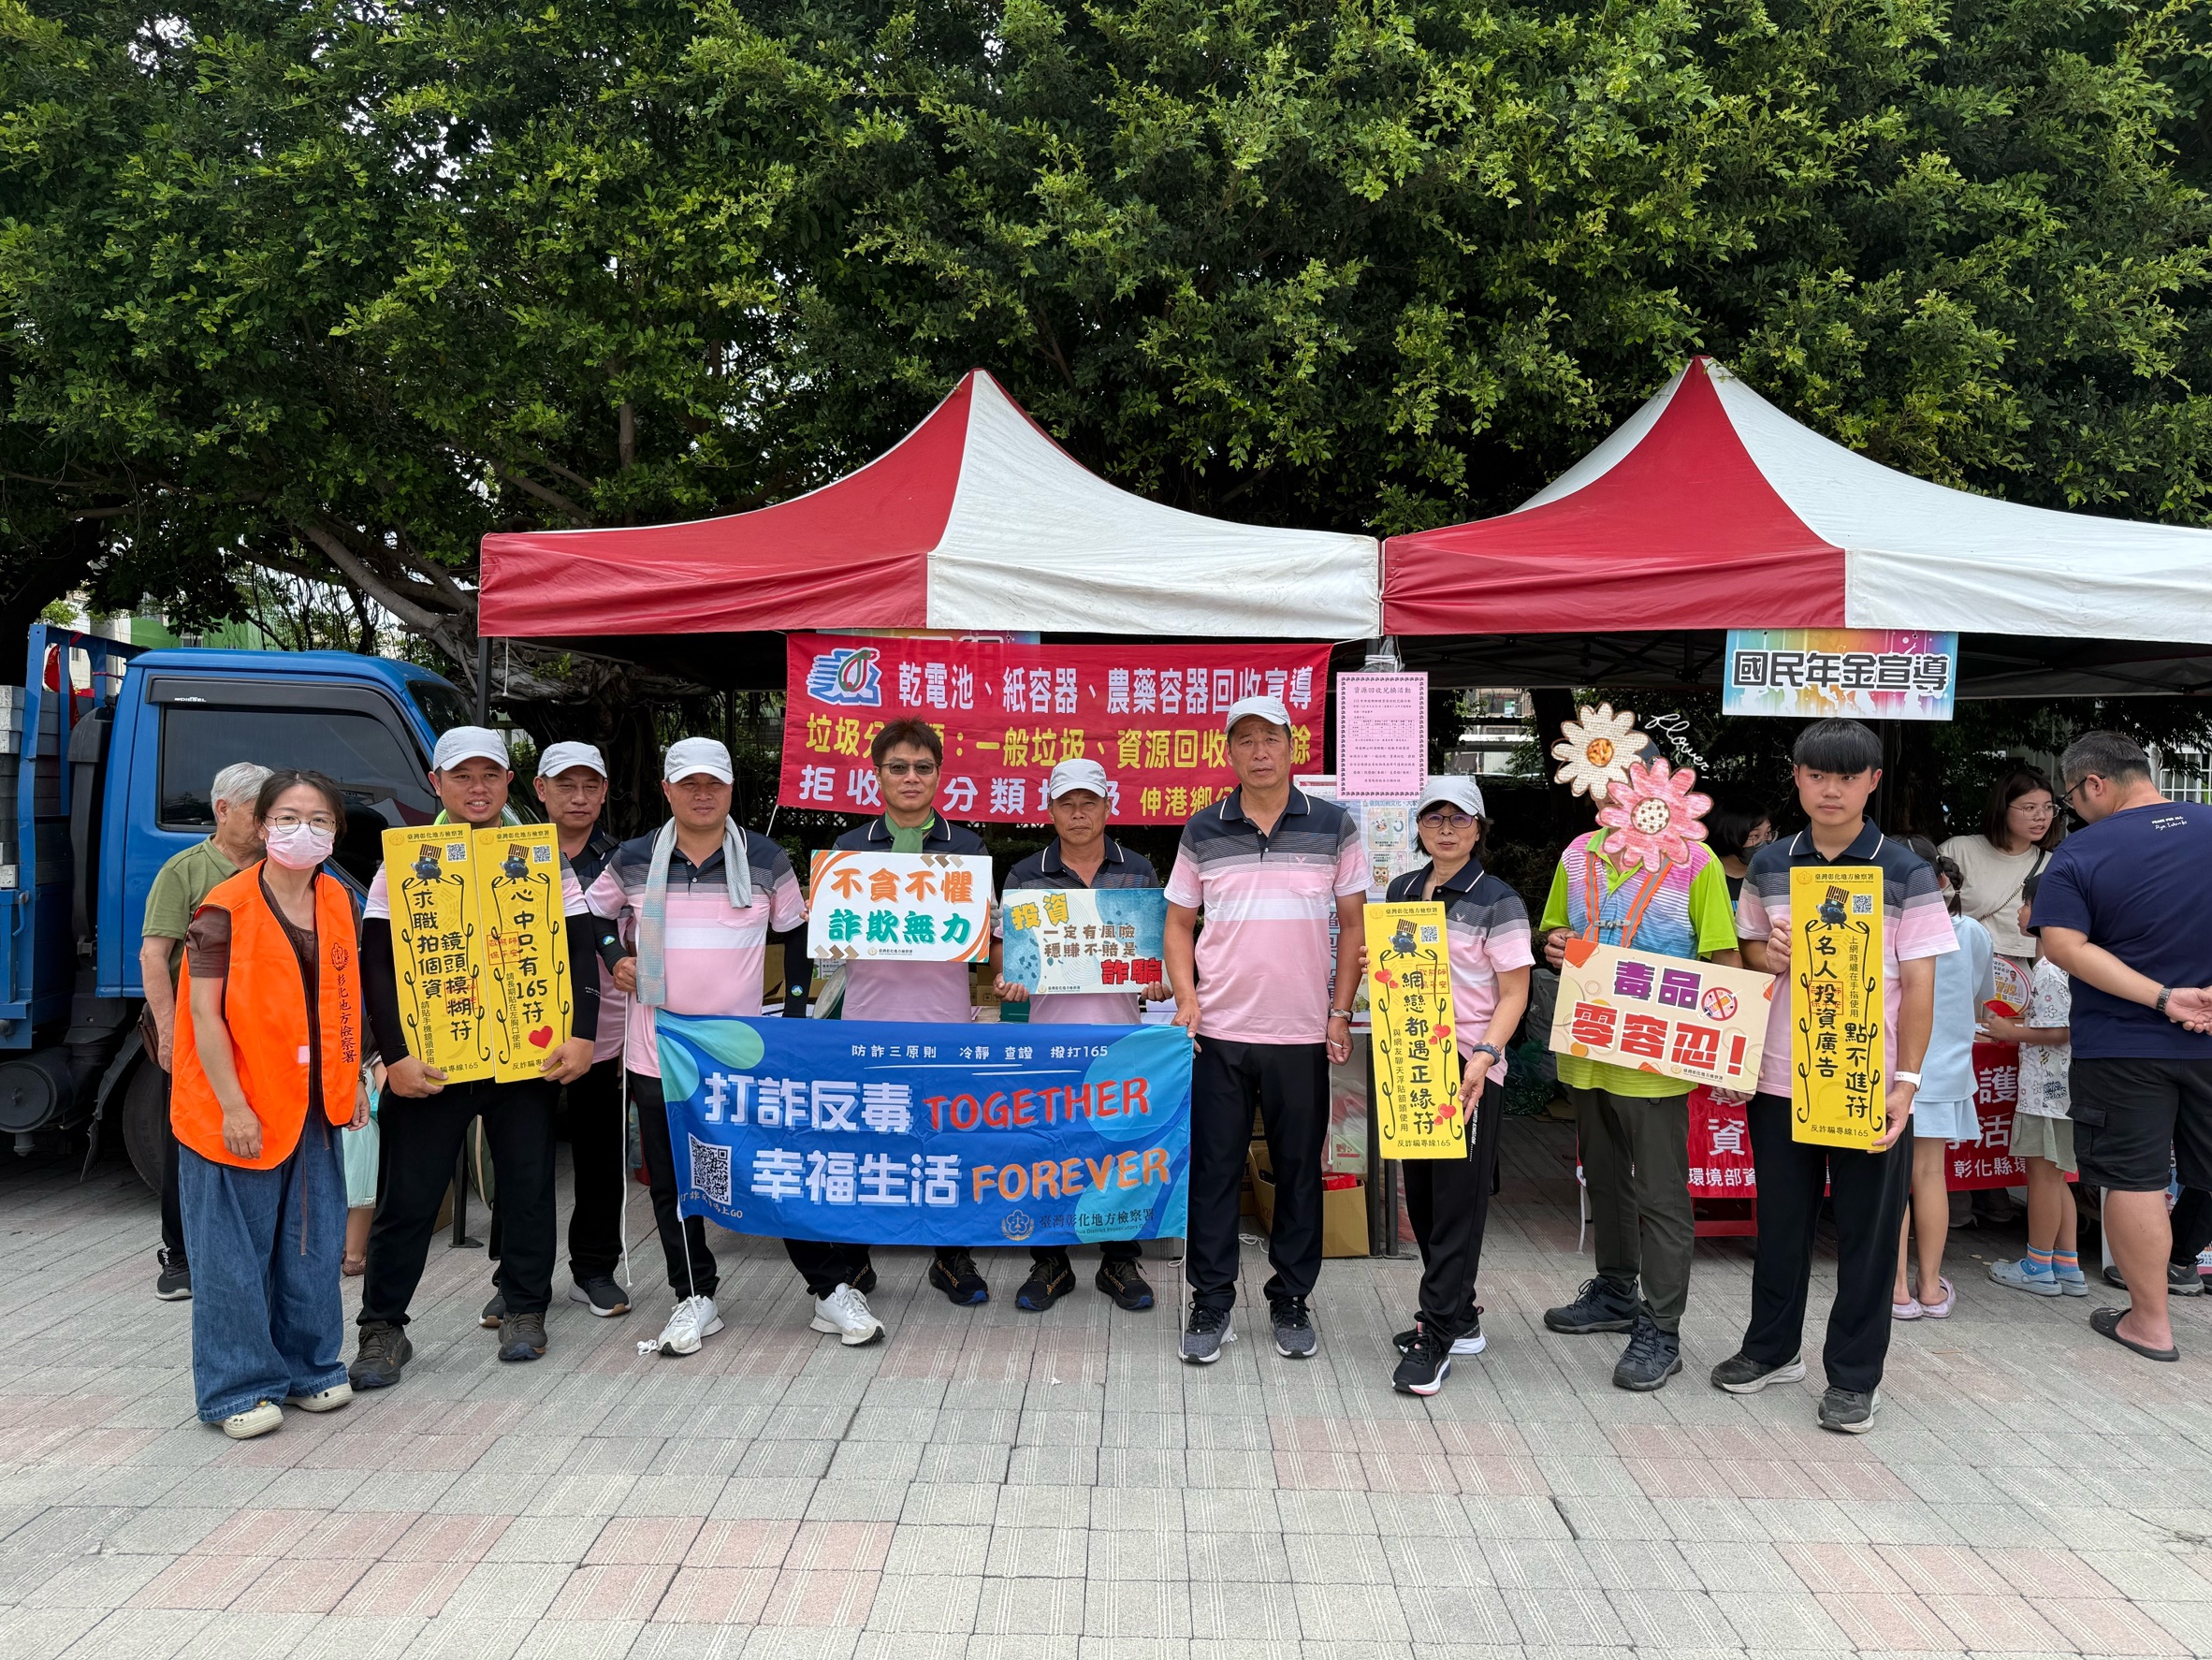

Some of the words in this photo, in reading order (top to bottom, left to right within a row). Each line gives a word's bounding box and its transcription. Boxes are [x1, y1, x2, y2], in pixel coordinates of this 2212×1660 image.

[1734, 650, 1949, 692] 國民年金宣導
[830, 867, 975, 905] 不貪不懼
[1011, 893, 1071, 931] 投資
[413, 889, 443, 999] 求職拍個資
[828, 909, 973, 945] 詐欺無力
[1043, 925, 1136, 939] 一定有風險
[1043, 940, 1137, 958] 穩賺不賠是
[512, 889, 548, 1025] 心中只有165符
[1100, 957, 1163, 985] 詐騙
[440, 931, 473, 1041] 鏡頭模糊符
[1613, 959, 1703, 1011] 毒品
[1814, 935, 1840, 1078] 名人投資廣告
[337, 974, 357, 1064] 彰化地方檢察署
[851, 1044, 937, 1058] 防詐三原則
[959, 1046, 990, 1059] 冷靜
[1004, 1046, 1033, 1059] 查證
[1050, 1045, 1109, 1059] 撥打165
[1402, 970, 1436, 1136] 網戀都遇正緣符
[1844, 1023, 1870, 1119] 點不進符
[705, 1071, 914, 1133] 打詐反毒
[923, 1076, 1151, 1131] TOGETHER
[1708, 1116, 1745, 1156] 資
[1810, 1125, 1870, 1137] 反詐騙專線165
[750, 1147, 960, 1205] 幸福生活
[972, 1147, 1171, 1203] FOREVER
